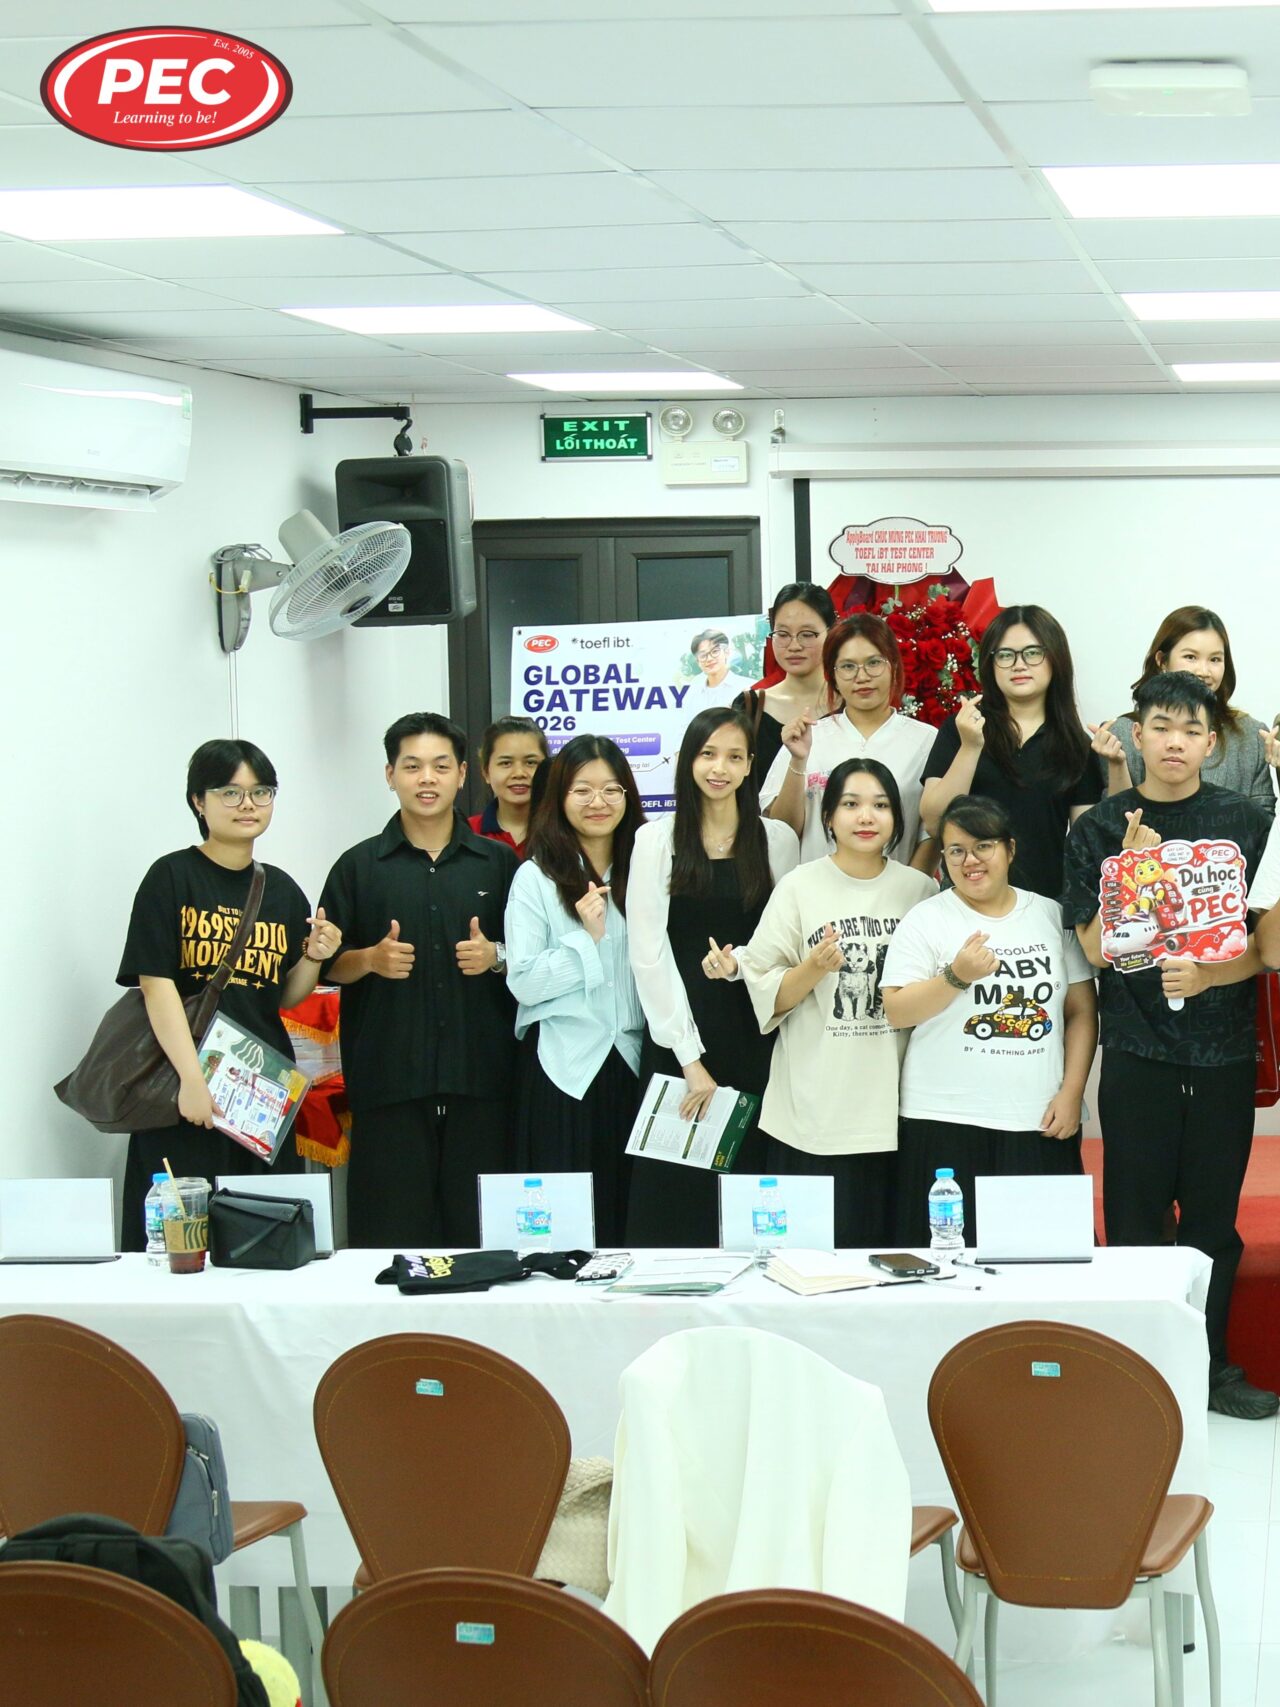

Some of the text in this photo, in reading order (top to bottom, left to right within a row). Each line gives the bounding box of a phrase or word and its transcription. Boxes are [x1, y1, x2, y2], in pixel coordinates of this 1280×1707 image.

[563, 421, 630, 432] EXIT
[556, 434, 638, 450] LỐI THOÁT
[855, 547, 934, 559] TOEFL iBT TEST CENTER
[531, 638, 552, 648] PEC
[523, 662, 639, 686] GLOBAL
[522, 684, 690, 713] GATEWAY
[534, 716, 576, 732] 026
[615, 737, 631, 745] Test
[632, 736, 656, 744] Center
[1211, 849, 1229, 857] PEC
[1178, 864, 1237, 887] Du học
[1197, 885, 1214, 895] cùng
[1188, 892, 1239, 923] PEC
[181, 905, 288, 954] 1969STDIO
[840, 917, 860, 939] ARE
[860, 916, 882, 937] TWO
[994, 956, 1051, 979] ABY
